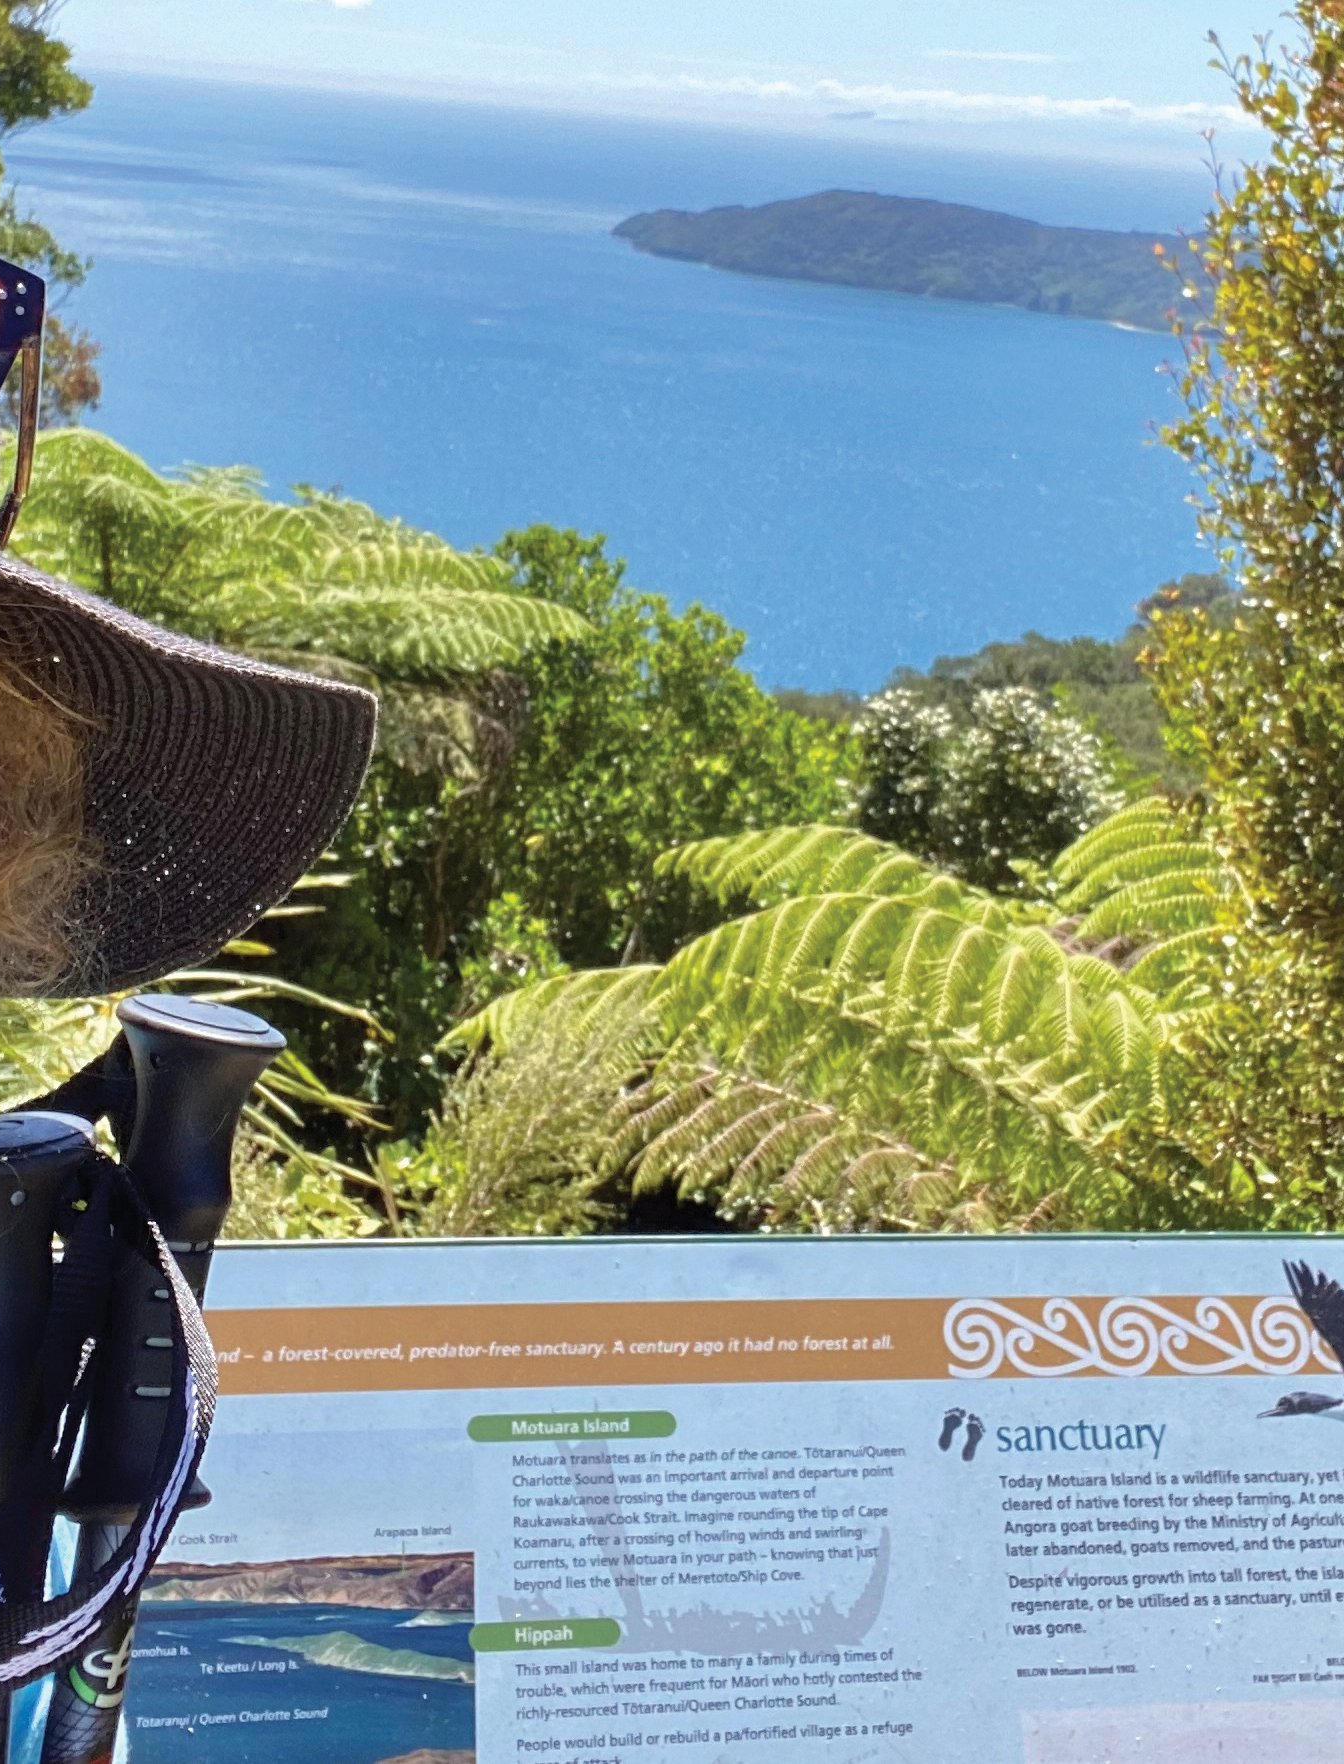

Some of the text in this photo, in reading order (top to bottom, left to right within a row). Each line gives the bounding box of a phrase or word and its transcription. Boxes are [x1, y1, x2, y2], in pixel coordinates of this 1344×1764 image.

[261, 1334, 895, 1364] a forest-covered, predator-free sanctuary. A century ago it had no forest at all.
[511, 1417, 630, 1435] Motuara Island
[996, 1419, 1166, 1460] sanctuary
[511, 1452, 567, 1467] Motuara
[569, 1450, 630, 1465] translates
[633, 1453, 647, 1463] as
[649, 1449, 662, 1463] in
[664, 1449, 686, 1462] the
[688, 1448, 718, 1466] path
[720, 1447, 736, 1461] of
[737, 1447, 759, 1460] the
[760, 1448, 801, 1460] canoe.
[998, 1475, 1043, 1493] Today
[1046, 1473, 1107, 1488] Motuara
[1110, 1472, 1152, 1486] Island
[1155, 1472, 1167, 1485] is
[1170, 1475, 1179, 1485] a
[1243, 1469, 1314, 1488] sanctuary,
[1316, 1468, 1340, 1486] yet
[178, 1533, 206, 1546] Cook
[208, 1531, 239, 1544] Strait
[513, 1524, 862, 1551] Koamaru, after a crossing of howling winds and swirling
[1005, 1543, 1038, 1557] later
[1042, 1540, 1126, 1558] abandoned,
[1130, 1539, 1169, 1558] goats
[1172, 1537, 1239, 1555] removed,
[1242, 1536, 1268, 1550] and
[1271, 1536, 1295, 1549] the
[513, 1567, 804, 1595] beyond lies the shelter of Meretoto/Ship Cove.
[1008, 1574, 1062, 1593] Despite
[1066, 1572, 1128, 1591] vigorous
[1132, 1570, 1184, 1589] growth
[1188, 1569, 1216, 1583] into
[1219, 1568, 1242, 1582] tall
[1246, 1567, 1291, 1584] forest,
[1294, 1566, 1318, 1580] the
[514, 1625, 573, 1646] Hippah
[1012, 1623, 1086, 1638] was gone.
[199, 1662, 213, 1676] Te
[216, 1660, 249, 1674] Keetu
[258, 1658, 285, 1674] Long
[288, 1658, 300, 1671] Is.
[514, 1647, 894, 1676] This small island was home to many a family during times of
[516, 1702, 618, 1724] richly-resourced
[734, 1694, 793, 1709] Charlotte
[796, 1692, 840, 1707] Sound.
[516, 1735, 560, 1755] People
[564, 1733, 605, 1748] would
[609, 1732, 642, 1746] build
[646, 1734, 660, 1744] or
[663, 1729, 709, 1744] rebuild
[712, 1731, 721, 1741] a
[799, 1722, 841, 1742] village
[844, 1725, 858, 1735] as
[860, 1724, 868, 1734] a
[871, 1719, 913, 1738] refuge
